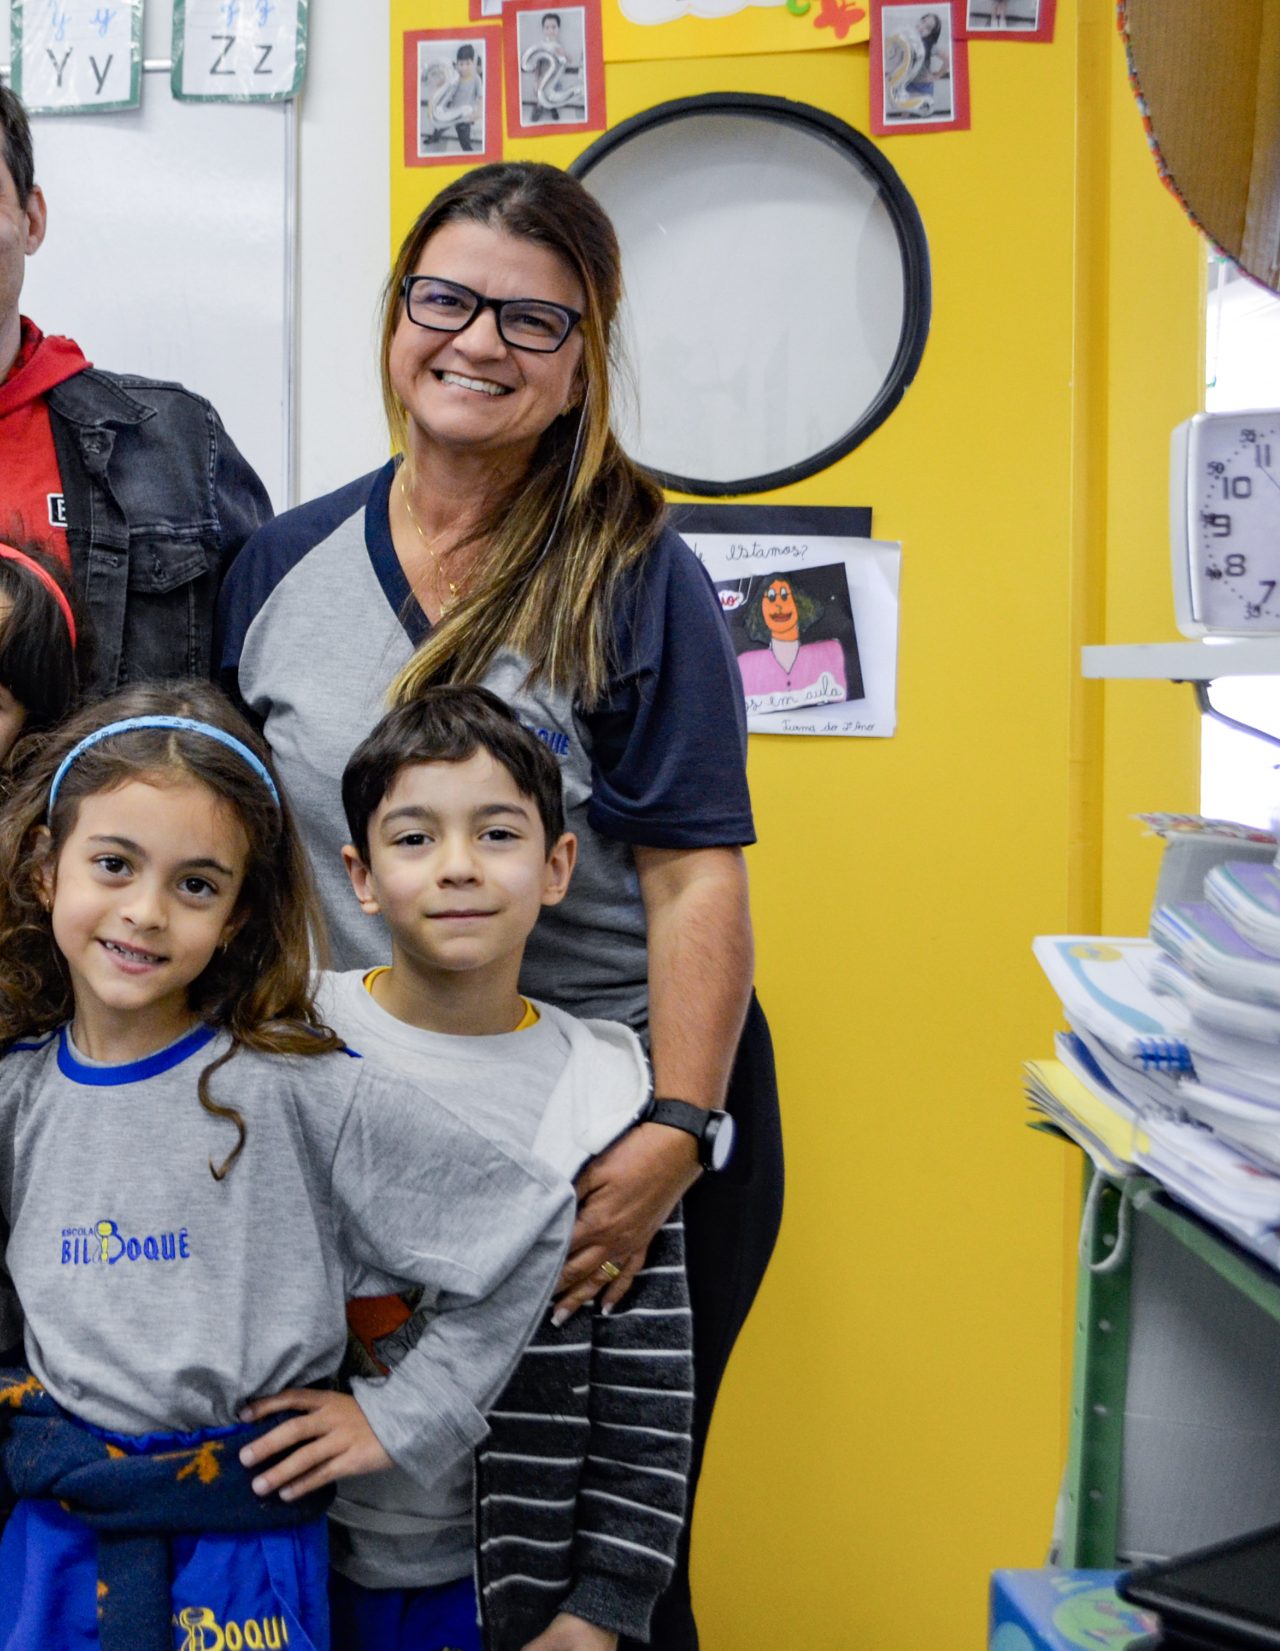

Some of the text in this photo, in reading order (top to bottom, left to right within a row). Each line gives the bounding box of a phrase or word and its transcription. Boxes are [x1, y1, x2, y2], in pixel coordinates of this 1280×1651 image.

[1223, 475, 1252, 501] 10
[1213, 513, 1232, 538] 9
[1225, 553, 1247, 578] 8
[1258, 580, 1277, 604] 7
[62, 1227, 94, 1237] ESCOLA
